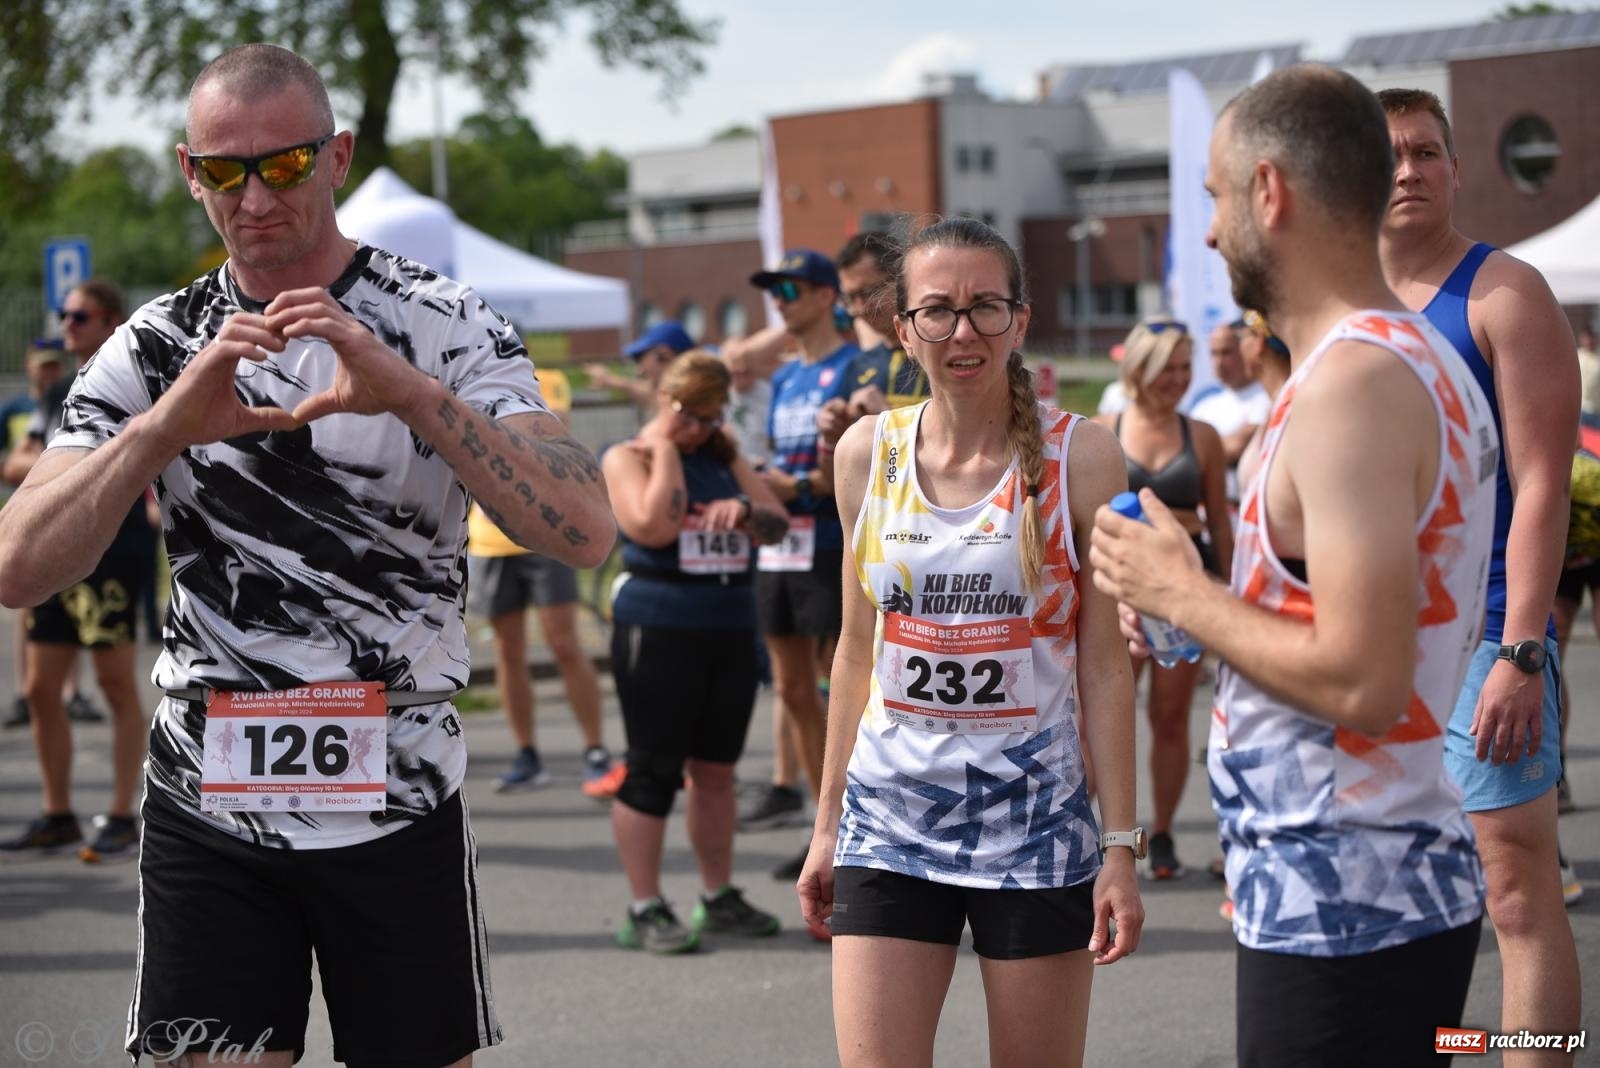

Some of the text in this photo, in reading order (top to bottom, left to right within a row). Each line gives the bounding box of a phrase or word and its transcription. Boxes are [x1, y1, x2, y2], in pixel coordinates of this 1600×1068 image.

[54, 248, 80, 304] P
[886, 447, 899, 483] deep
[696, 533, 739, 556] 146
[923, 573, 992, 593] XII BIEG
[920, 590, 1028, 616] KOZIOŁKÓW
[899, 619, 1010, 639] XVI BIEG BEZ GRANIC
[906, 655, 1005, 705] 232
[231, 687, 366, 701] XVI BIEG BEZ GRANIC
[319, 700, 365, 709] Kędzierskiego
[244, 724, 349, 776] 126
[285, 785, 299, 793] Bieg
[299, 785, 324, 793] Główny
[325, 796, 362, 805] Racibórz
